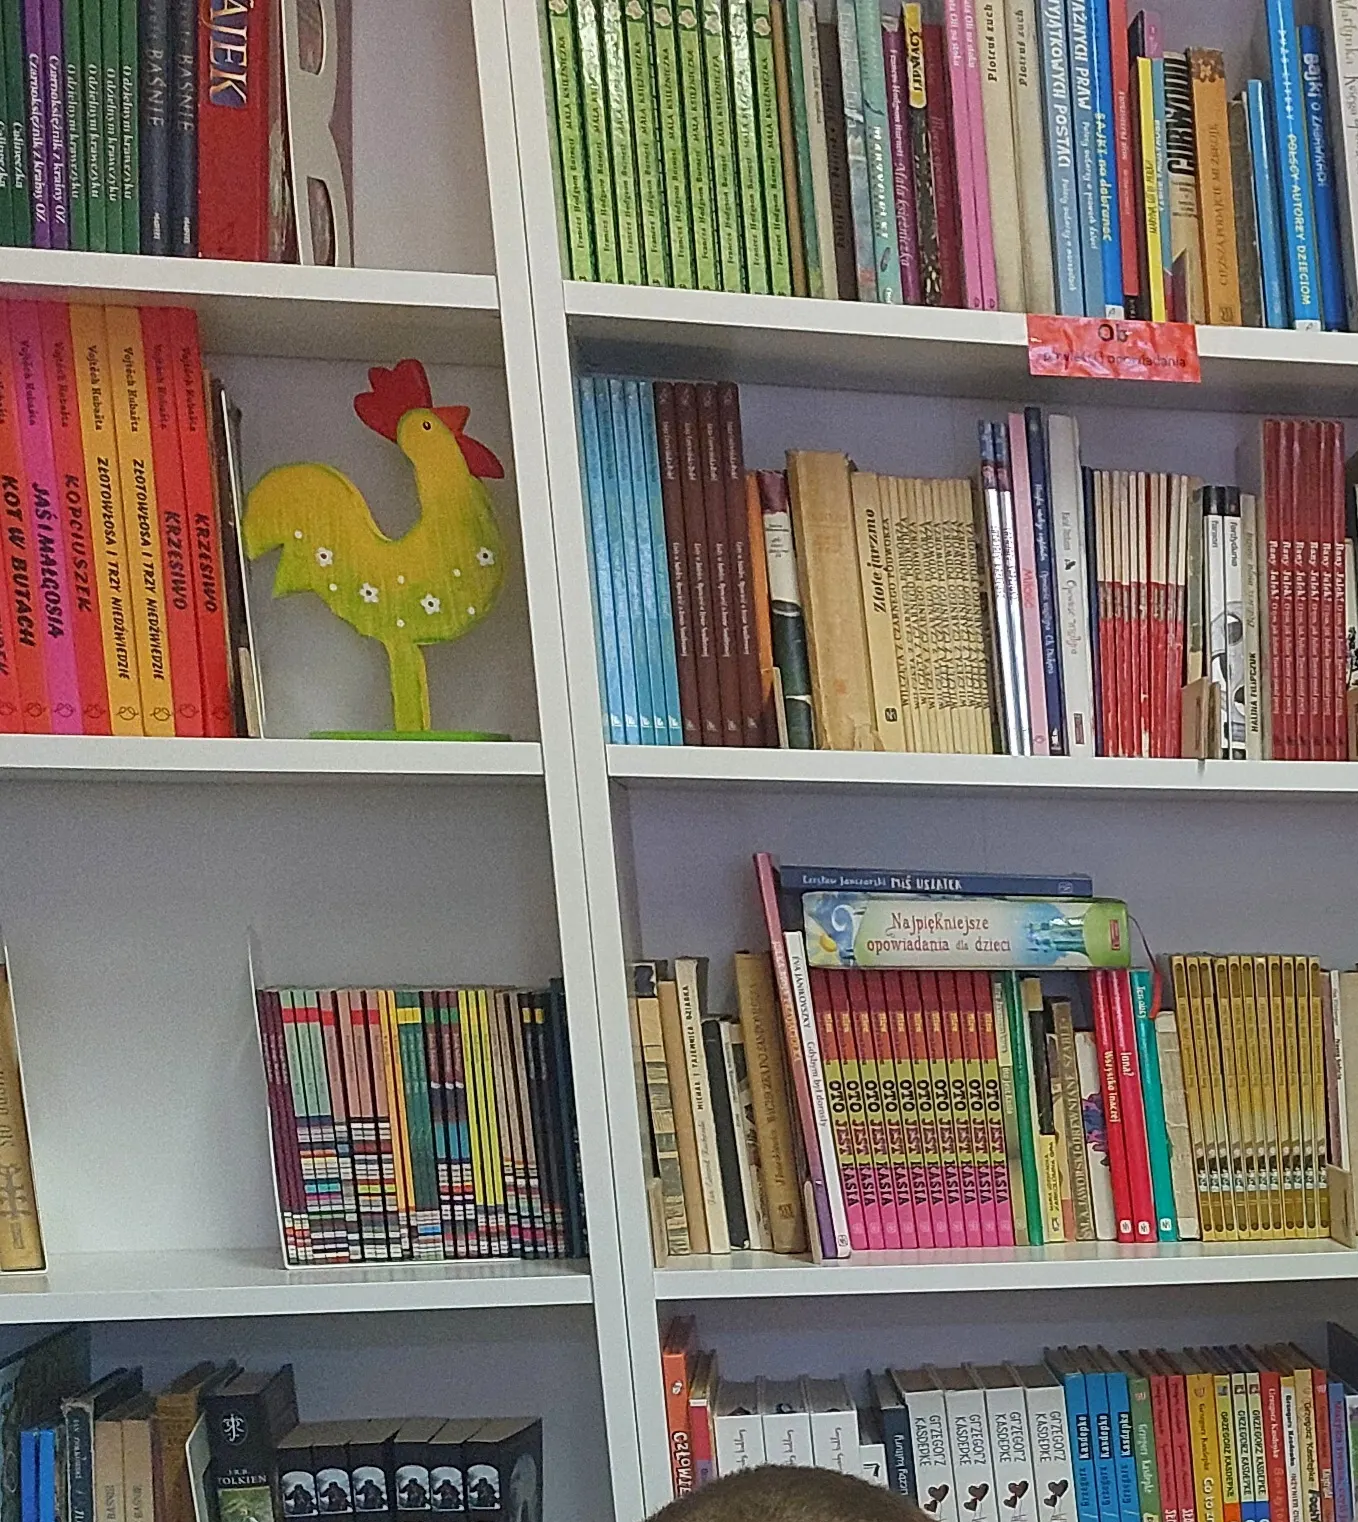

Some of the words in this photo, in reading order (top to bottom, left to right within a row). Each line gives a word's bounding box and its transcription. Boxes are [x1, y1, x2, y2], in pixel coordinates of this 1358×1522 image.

[1071, 0, 1090, 60] AŻNYCH
[1044, 0, 1068, 104] YJĄTKOWYCH
[1056, 107, 1072, 167] POSTACI
[1075, 67, 1092, 110] PRAW
[1303, 53, 1323, 97] Bajki
[1289, 185, 1305, 240] AUTORZY
[1296, 245, 1311, 305] DZIECIOM
[1, 476, 22, 518] KOT
[65, 475, 92, 612] KOPCIUSZEK
[97, 457, 117, 545] ZŁOTOWŁOSA
[108, 561, 122, 591] TRZY
[132, 459, 152, 547] ZŁOTOWŁOSA
[144, 563, 156, 592] TRZY
[866, 508, 883, 571] jarzmo
[164, 511, 187, 609] KRZESIWO
[194, 513, 218, 612] KRZESIWO
[11, 558, 36, 646] BUTACH
[871, 573, 887, 613] Złote
[867, 936, 950, 955] opowiadania
[956, 939, 969, 950] dla
[975, 937, 1011, 952] dzieci
[885, 911, 989, 938] Najpiękniejsze
[1104, 1050, 1117, 1090] Wszystko
[1120, 1051, 1134, 1076] Inna?
[952, 1080, 967, 1112] OTO
[969, 1080, 983, 1112] OTO
[985, 1080, 1000, 1111] OTO
[934, 1080, 949, 1112] OTO
[944, 1160, 960, 1204] KASIA
[956, 1118, 971, 1155] JEST
[973, 1118, 988, 1155] JEST
[989, 1118, 1004, 1154] JEST
[961, 1160, 976, 1204] KASIA
[977, 1160, 993, 1204] KASIA
[993, 1160, 1008, 1204] KASIA
[893, 1435, 905, 1466] kultury
[914, 1416, 931, 1467] KASDEPKE
[928, 1415, 946, 1466] GRZEGORZ
[954, 1416, 972, 1465] KASDEPKE
[968, 1414, 986, 1465] GRZEGORZ
[995, 1413, 1012, 1463] KASDEPKE
[1009, 1411, 1026, 1462] GRZEGORZ
[1203, 1476, 1214, 1493] Co
[1205, 1496, 1215, 1508] to
